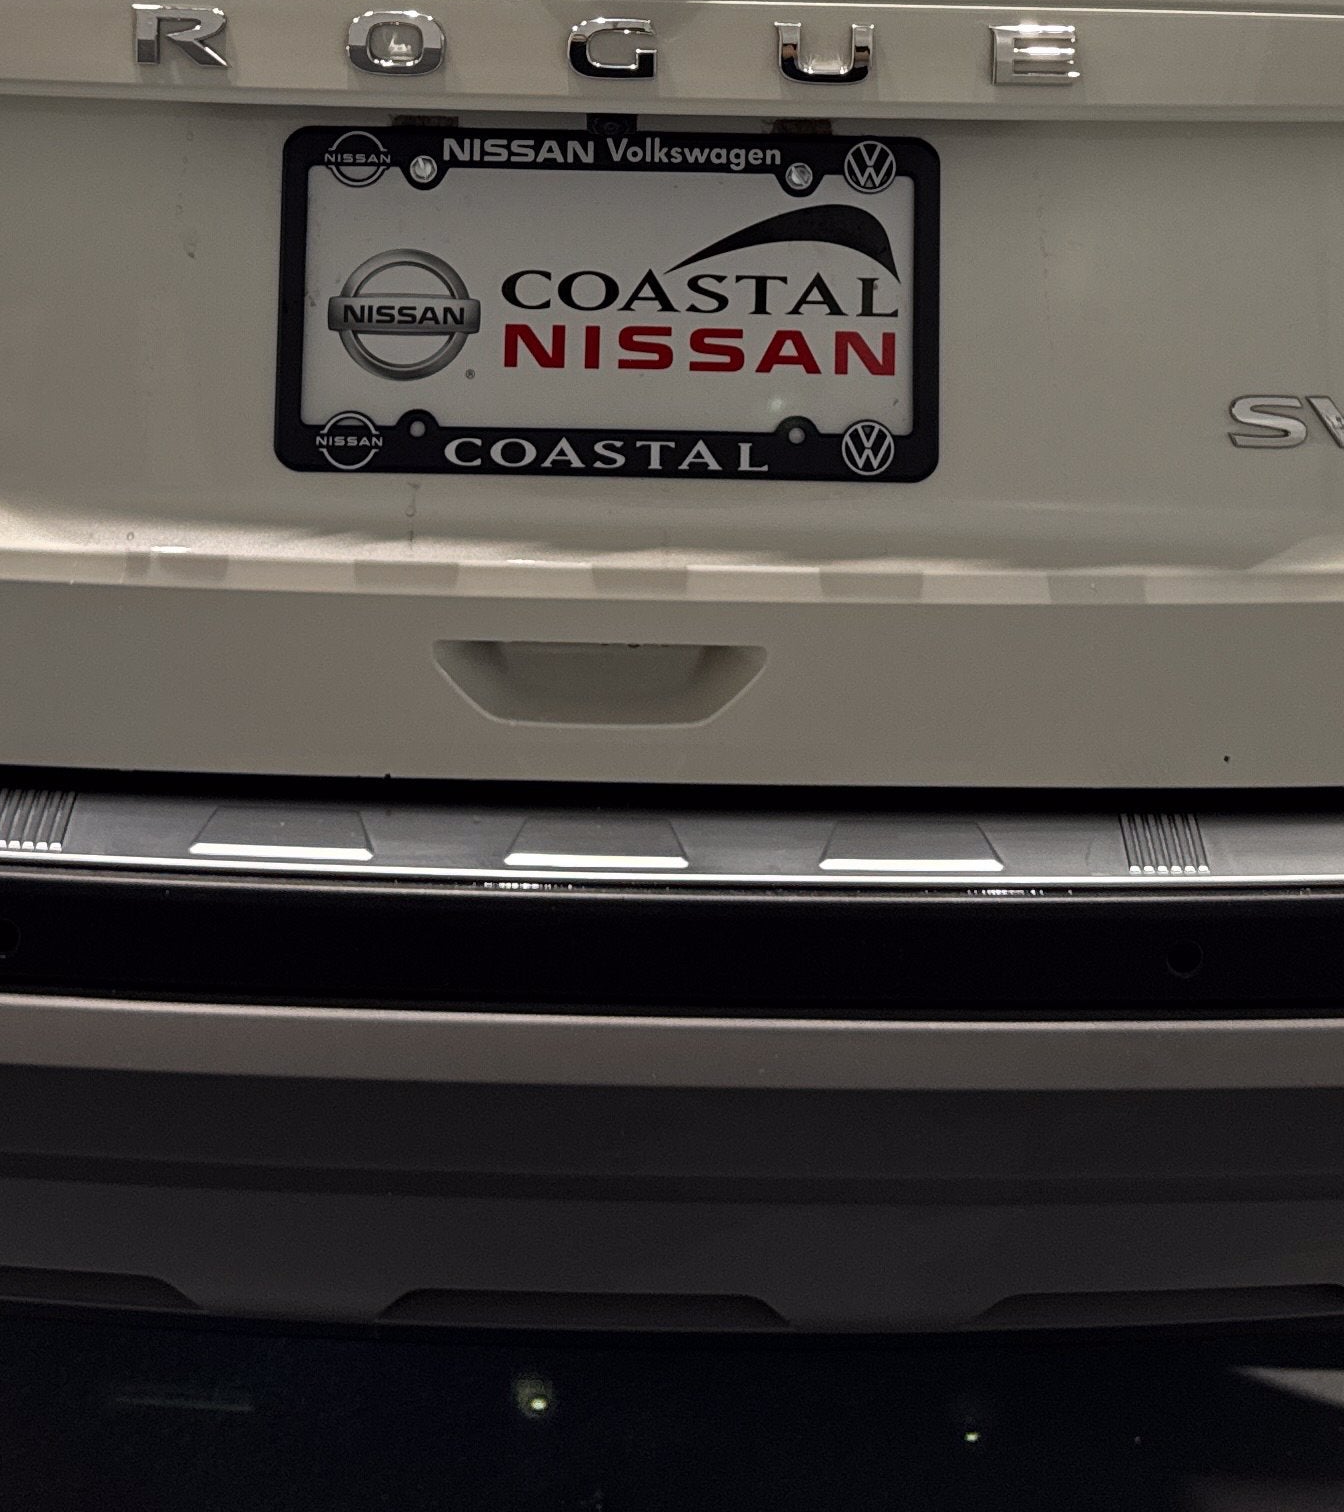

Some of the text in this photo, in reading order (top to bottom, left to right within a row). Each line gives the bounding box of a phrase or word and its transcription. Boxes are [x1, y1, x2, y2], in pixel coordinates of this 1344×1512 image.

[132, 4, 1082, 87] ROGUE
[324, 152, 391, 164] NISSAN
[443, 138, 781, 171] NISSAN Volkswagen
[501, 268, 899, 318] COASTAL
[343, 303, 466, 326] NISSAN
[504, 323, 896, 377] NISSAN
[315, 435, 383, 448] NISSAN
[444, 437, 769, 472] COASTAL
